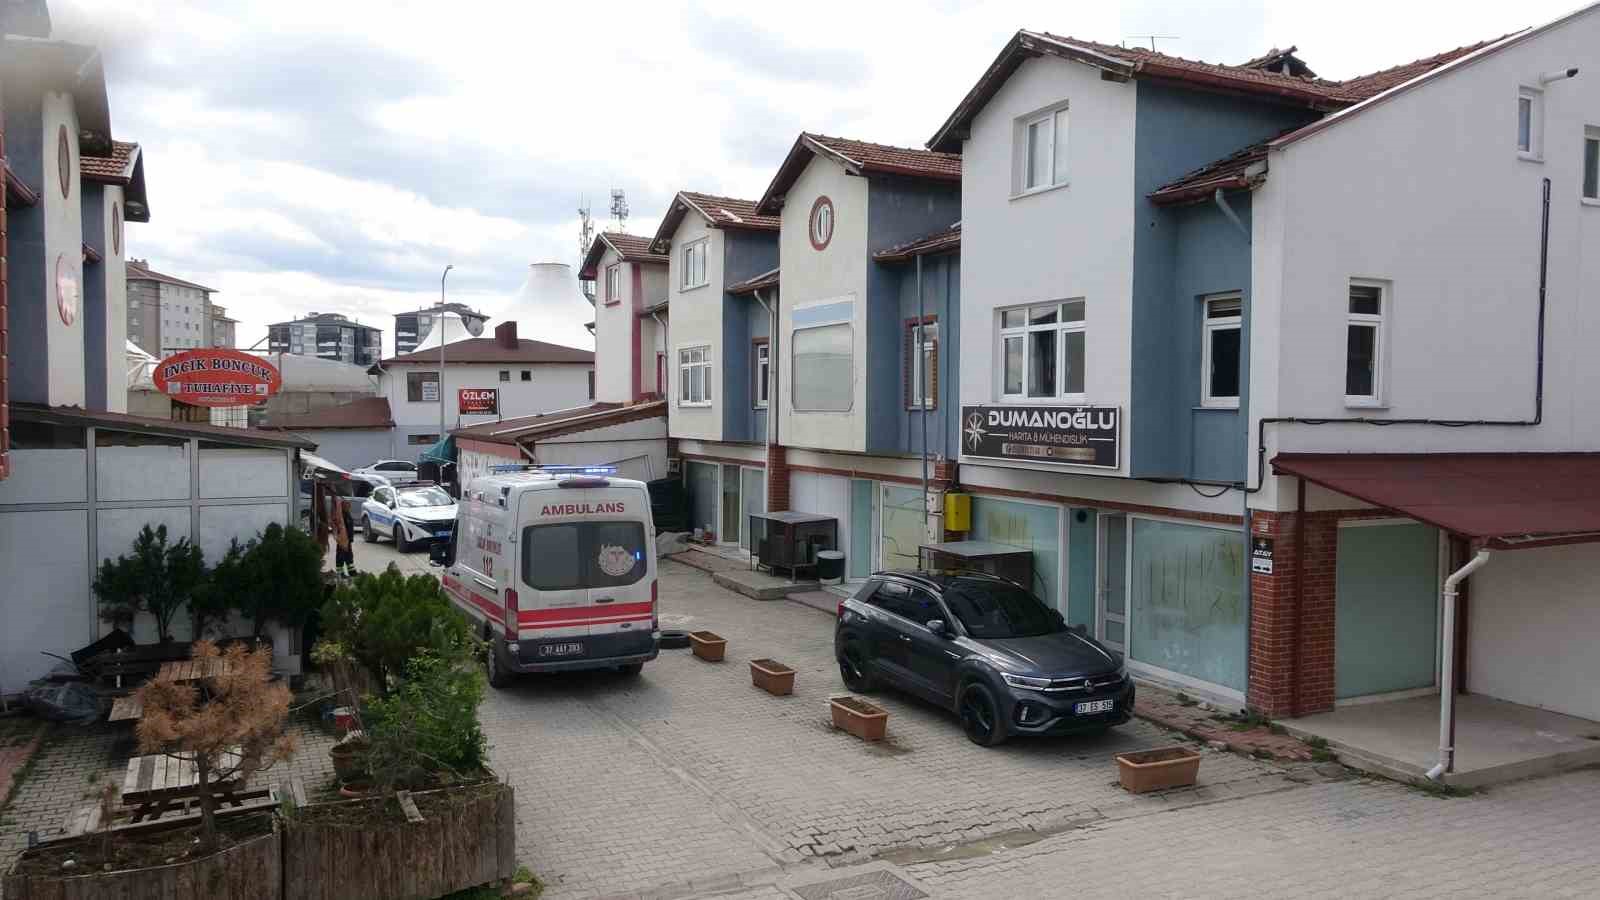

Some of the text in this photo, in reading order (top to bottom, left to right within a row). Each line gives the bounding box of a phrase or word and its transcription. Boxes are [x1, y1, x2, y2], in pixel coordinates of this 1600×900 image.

[212, 359, 273, 383] BONCUK
[462, 389, 495, 400] ÖZLEM
[988, 408, 1114, 429] DUMANOĞLU
[541, 502, 625, 516] AMBULANS
